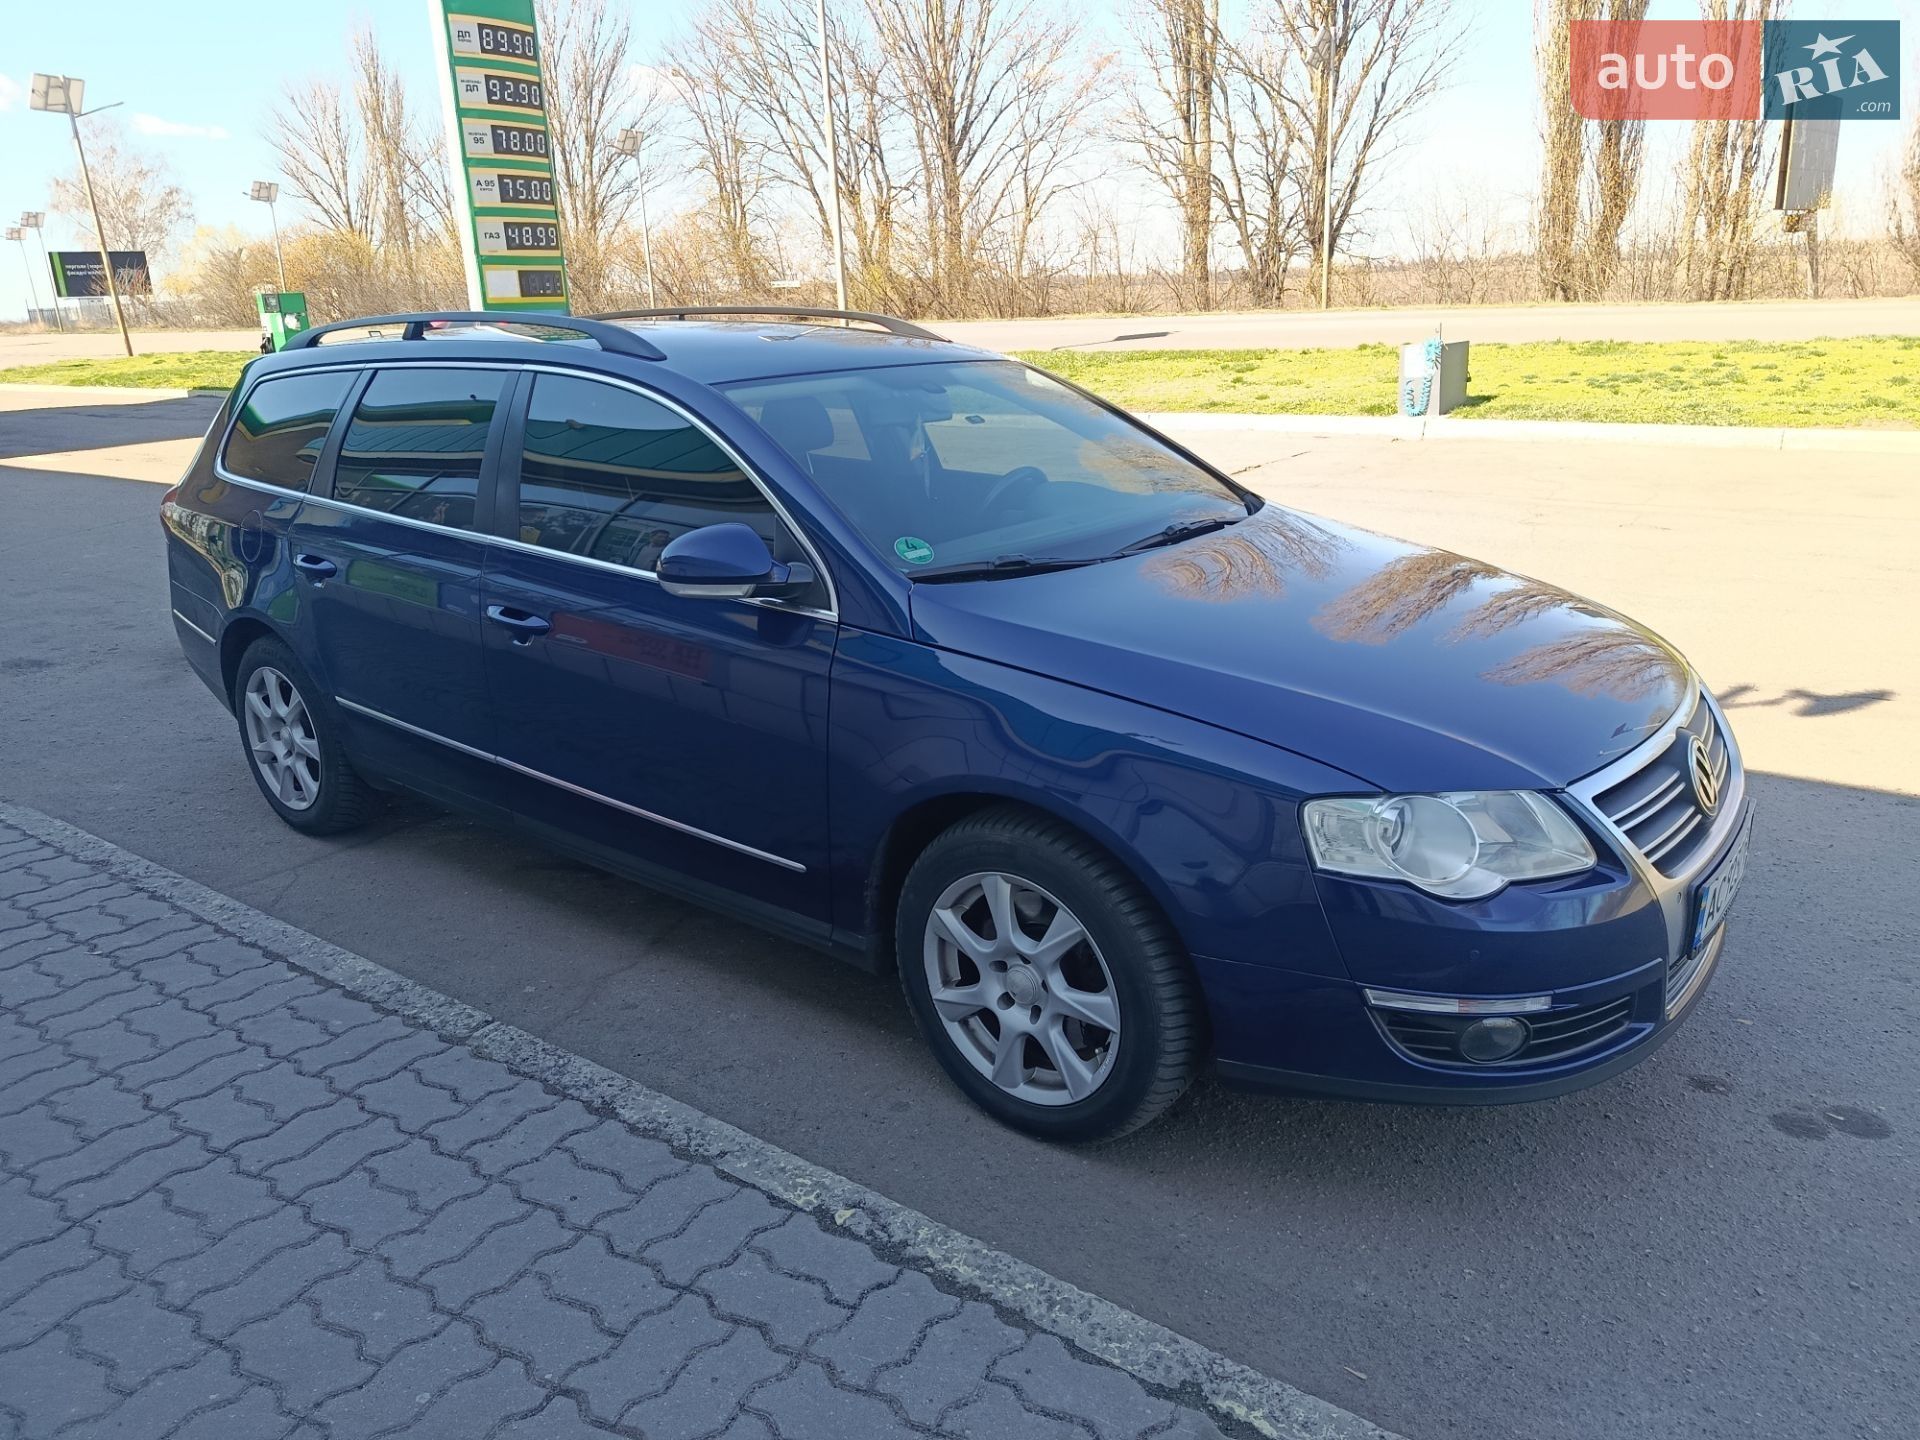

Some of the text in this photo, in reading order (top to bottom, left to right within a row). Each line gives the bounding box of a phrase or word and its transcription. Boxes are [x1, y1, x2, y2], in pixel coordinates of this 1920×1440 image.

[457, 30, 471, 39] ДП
[482, 28, 534, 57] 89.90
[489, 79, 540, 106] 92.90
[473, 136, 485, 145] 95
[496, 129, 546, 154] 78.00
[484, 179, 495, 188] 95
[503, 178, 551, 201] 75.00
[484, 232, 501, 240] ГАЗ
[508, 226, 557, 246] 48.99
